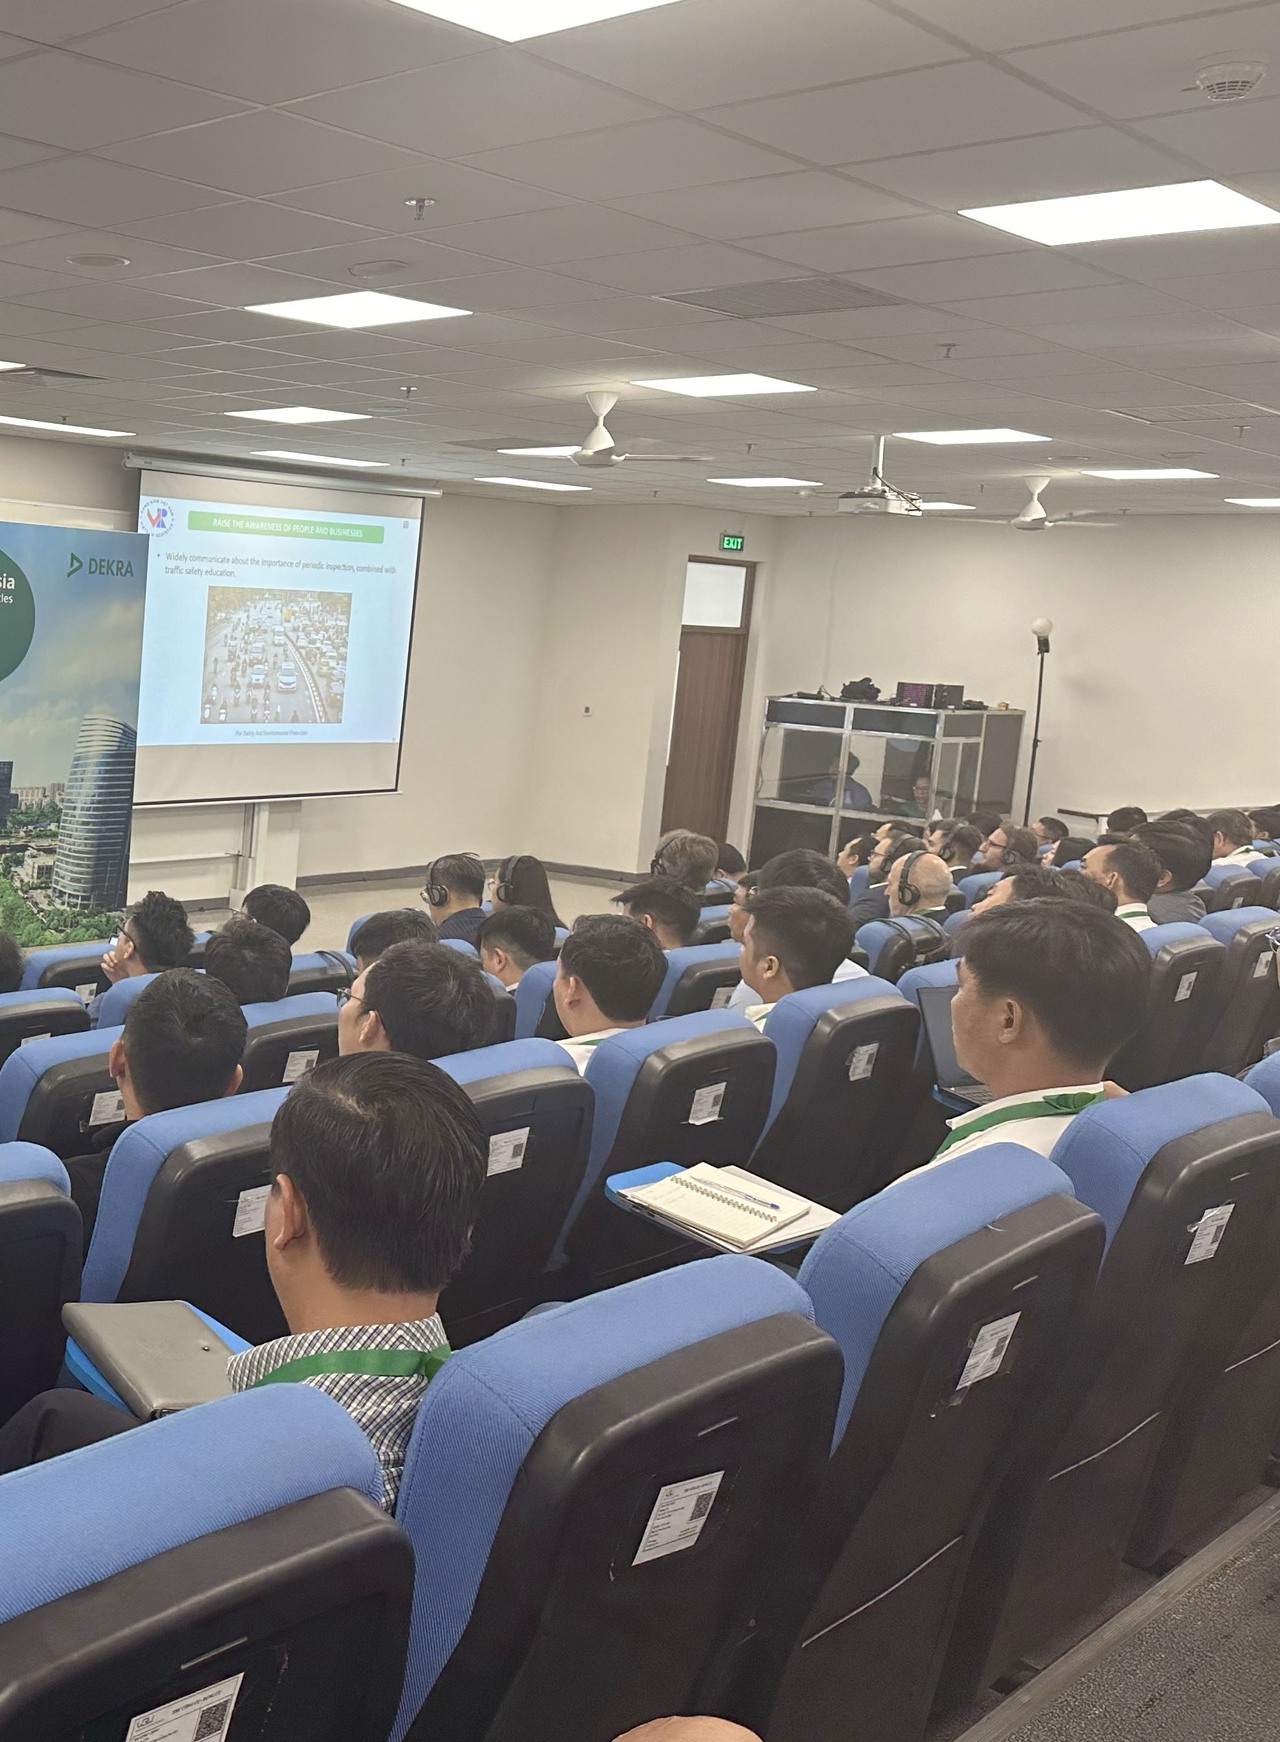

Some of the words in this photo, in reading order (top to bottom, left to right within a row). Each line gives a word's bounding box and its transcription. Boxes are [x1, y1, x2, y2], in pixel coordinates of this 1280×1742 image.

[212, 518, 231, 528] RAISE
[233, 519, 244, 529] THE
[245, 520, 282, 532] AWARENESS
[283, 523, 292, 532] OF
[293, 524, 314, 534] PEOPLE
[315, 526, 328, 535] AND
[329, 526, 363, 538] BUSINESSES
[723, 536, 743, 549] EXIT
[88, 558, 134, 577] DEKRA
[165, 565, 183, 575] traffic
[185, 566, 203, 578] safety
[166, 552, 187, 563] Widely
[189, 553, 230, 565] communicate
[231, 555, 249, 566] about
[250, 557, 260, 566] the
[295, 559, 302, 568] of
[302, 560, 324, 572] periodic
[356, 563, 383, 574] combined
[385, 564, 396, 574] with
